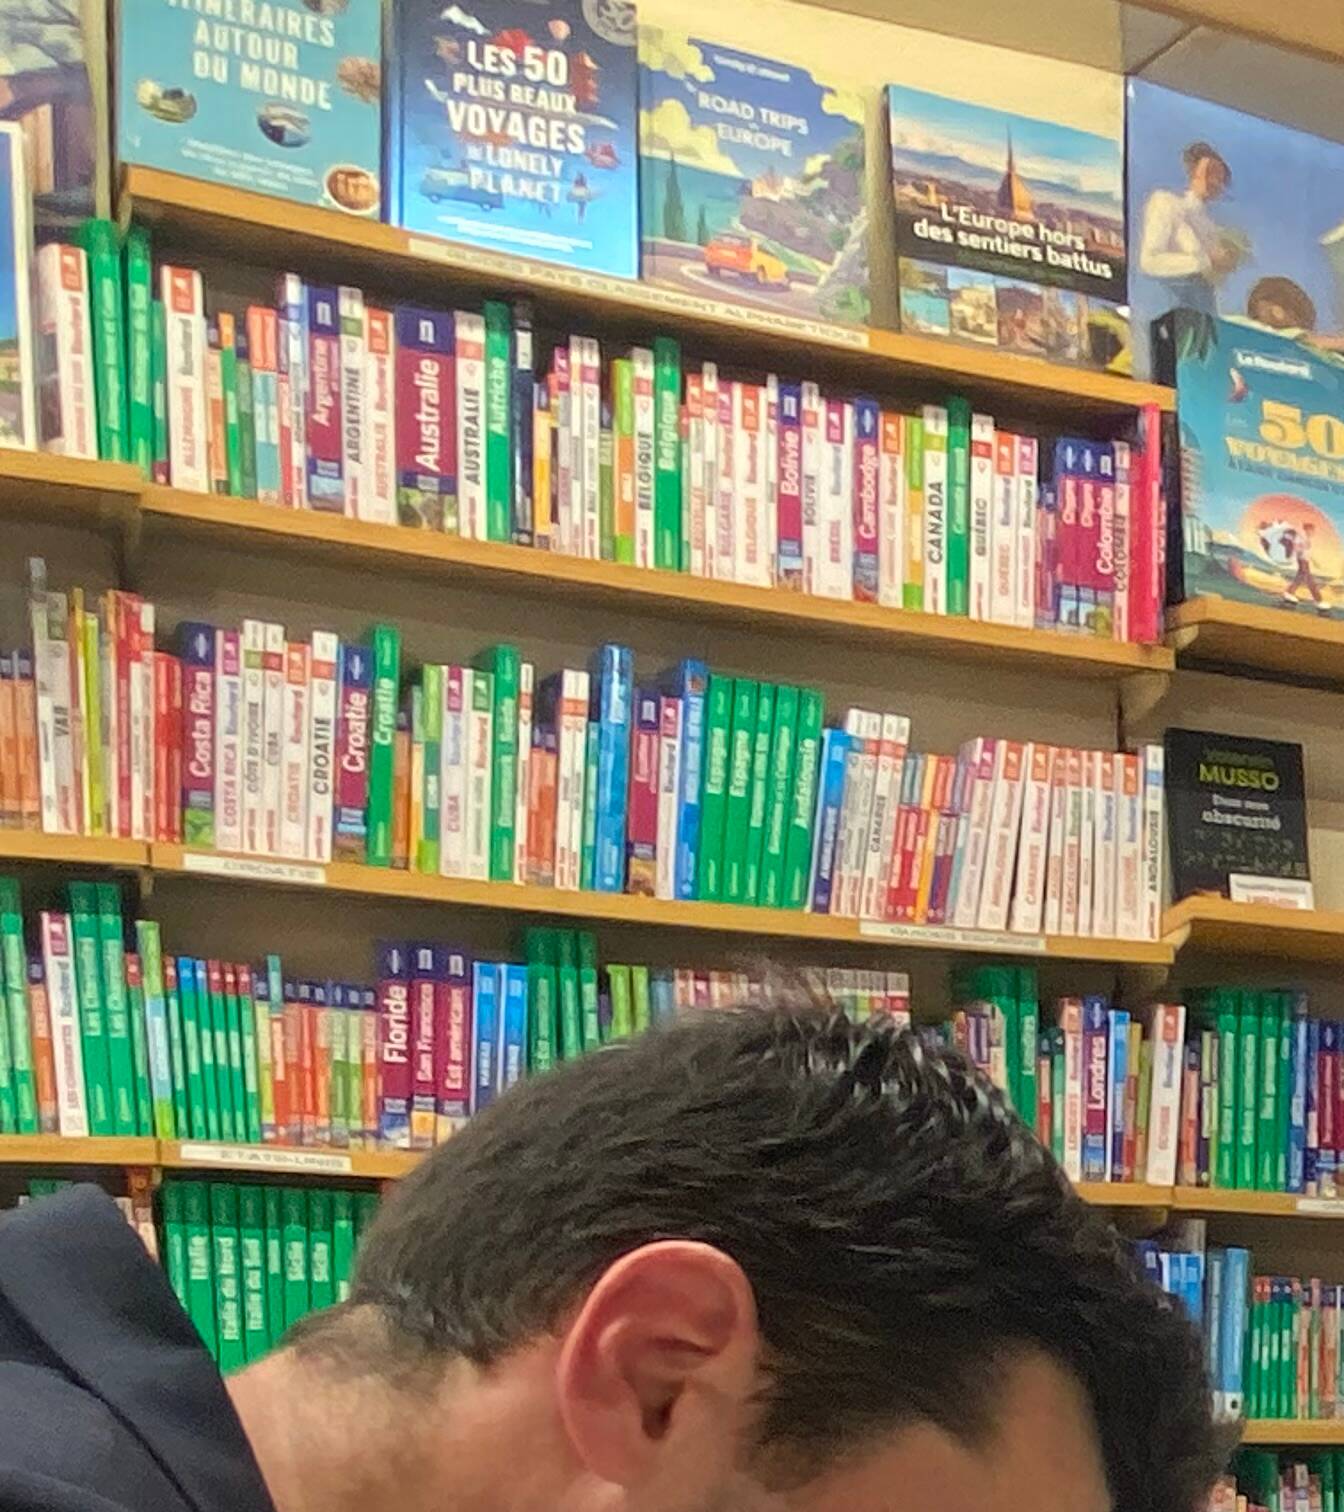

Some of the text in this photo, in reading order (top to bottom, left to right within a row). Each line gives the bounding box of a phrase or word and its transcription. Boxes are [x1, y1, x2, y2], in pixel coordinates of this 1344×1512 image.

[193, 18, 299, 70] AUTOUR
[466, 40, 568, 86] LES 50
[192, 50, 333, 111] DU MONDE
[453, 72, 577, 114] PLUS BEAUX
[698, 91, 808, 136] ROAD TRIPS
[447, 99, 586, 154] VOYAGES
[485, 144, 564, 178] LONELY
[717, 122, 792, 157] EUROPE
[470, 167, 561, 204] PLANET
[913, 218, 1113, 279] des sentiers battus
[941, 202, 1085, 250] L'Europe hors
[312, 338, 333, 428] Argentine
[346, 366, 362, 464] ARGENTINE
[414, 358, 440, 472] Australie
[488, 356, 506, 435] Autriche
[465, 388, 480, 485] AUSTRALIE
[658, 391, 679, 471] Belgique
[782, 432, 799, 495] Bolivie
[638, 432, 651, 509] BELGIQUE
[860, 444, 877, 538] Cambodge
[928, 481, 942, 564] CANADA
[1097, 488, 1113, 574] Colombie
[189, 671, 210, 777] Costa Rica
[343, 692, 367, 772] Croatie
[373, 677, 394, 746] Croatie
[313, 717, 331, 795] CROATIE
[707, 727, 725, 794] Espagne
[730, 730, 750, 797] Espagne
[794, 739, 816, 829] Andalousie
[1199, 764, 1280, 790] MUSSO
[1149, 811, 1158, 892] ANDALOUSIE
[1202, 809, 1281, 831] obscurité
[386, 985, 407, 1063] Floride
[1089, 1037, 1105, 1109] Londres
